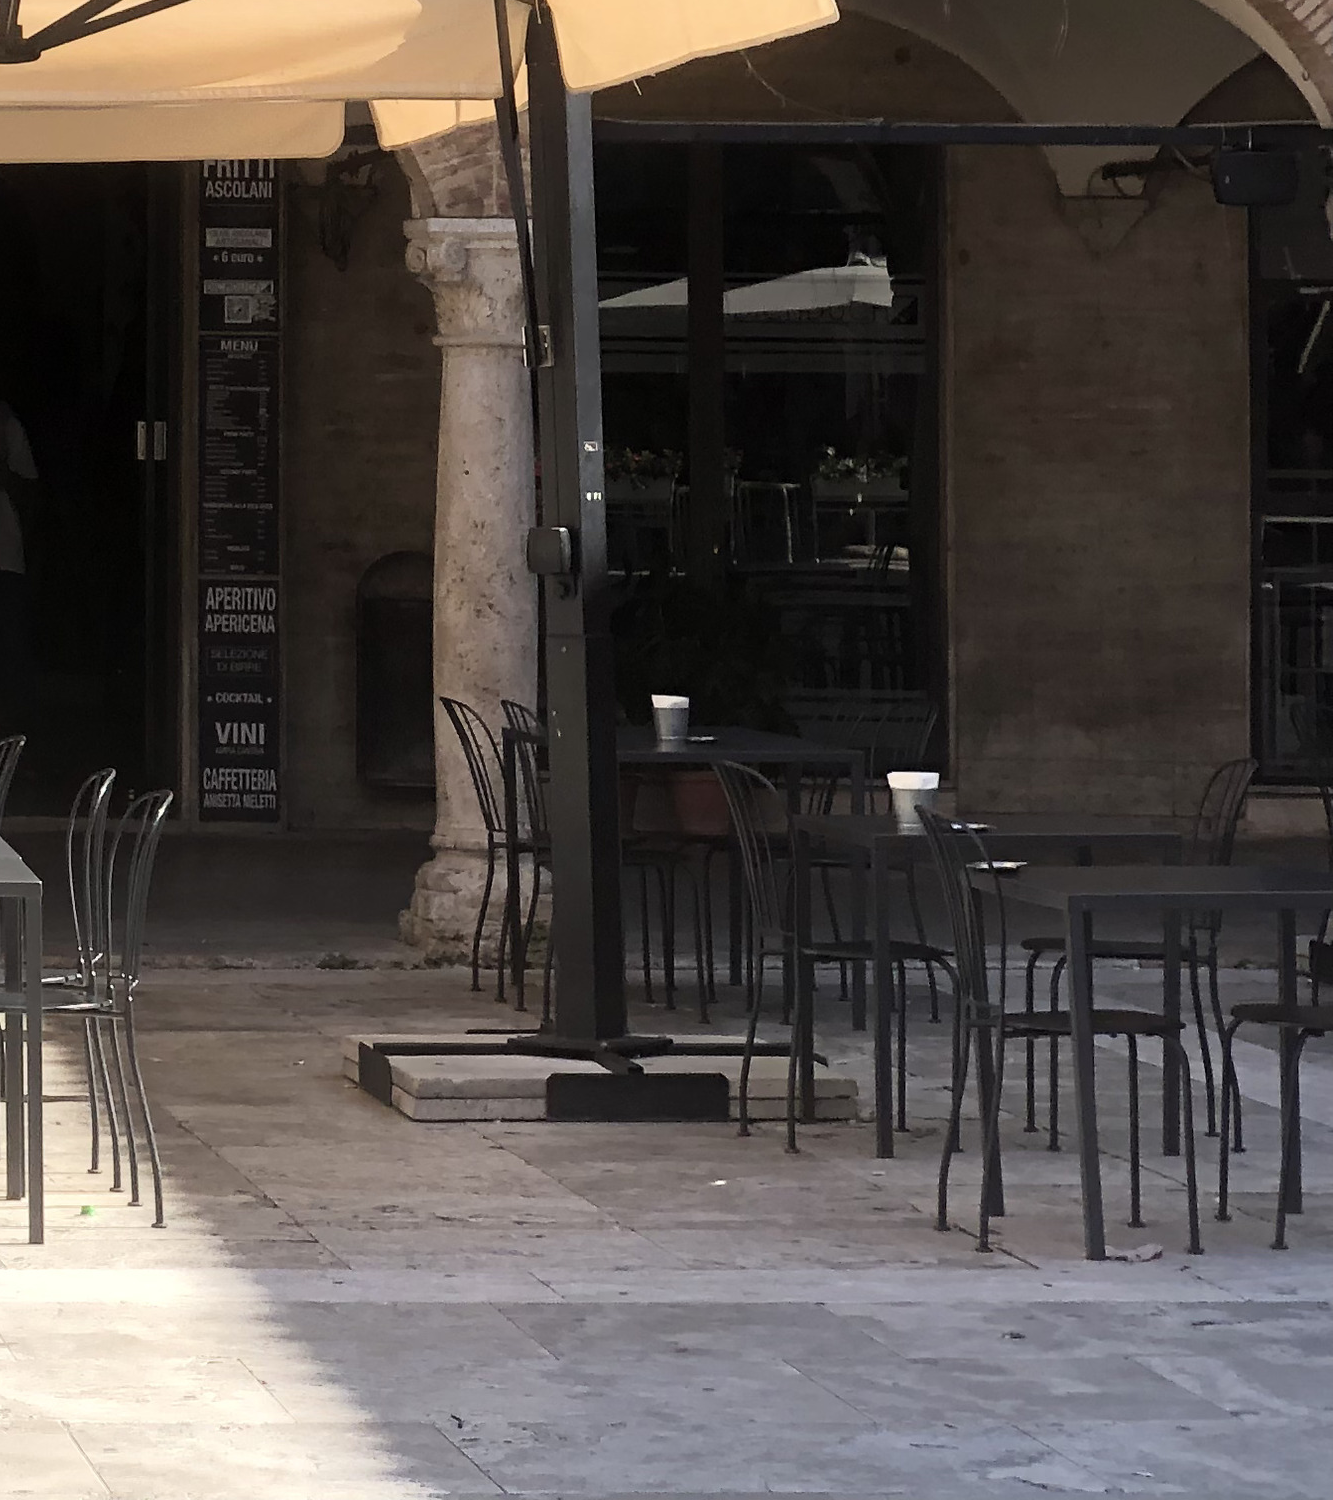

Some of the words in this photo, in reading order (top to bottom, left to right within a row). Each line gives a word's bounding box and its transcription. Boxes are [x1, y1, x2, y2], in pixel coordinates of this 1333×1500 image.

[205, 180, 272, 199] ASCOLANI
[220, 340, 259, 351] MENU
[205, 587, 276, 611] APERITIVO
[204, 614, 275, 633] APERICENA
[215, 692, 264, 704] COCKTAIL
[215, 722, 265, 745] VINI
[203, 767, 277, 791] CAFFETTERIA
